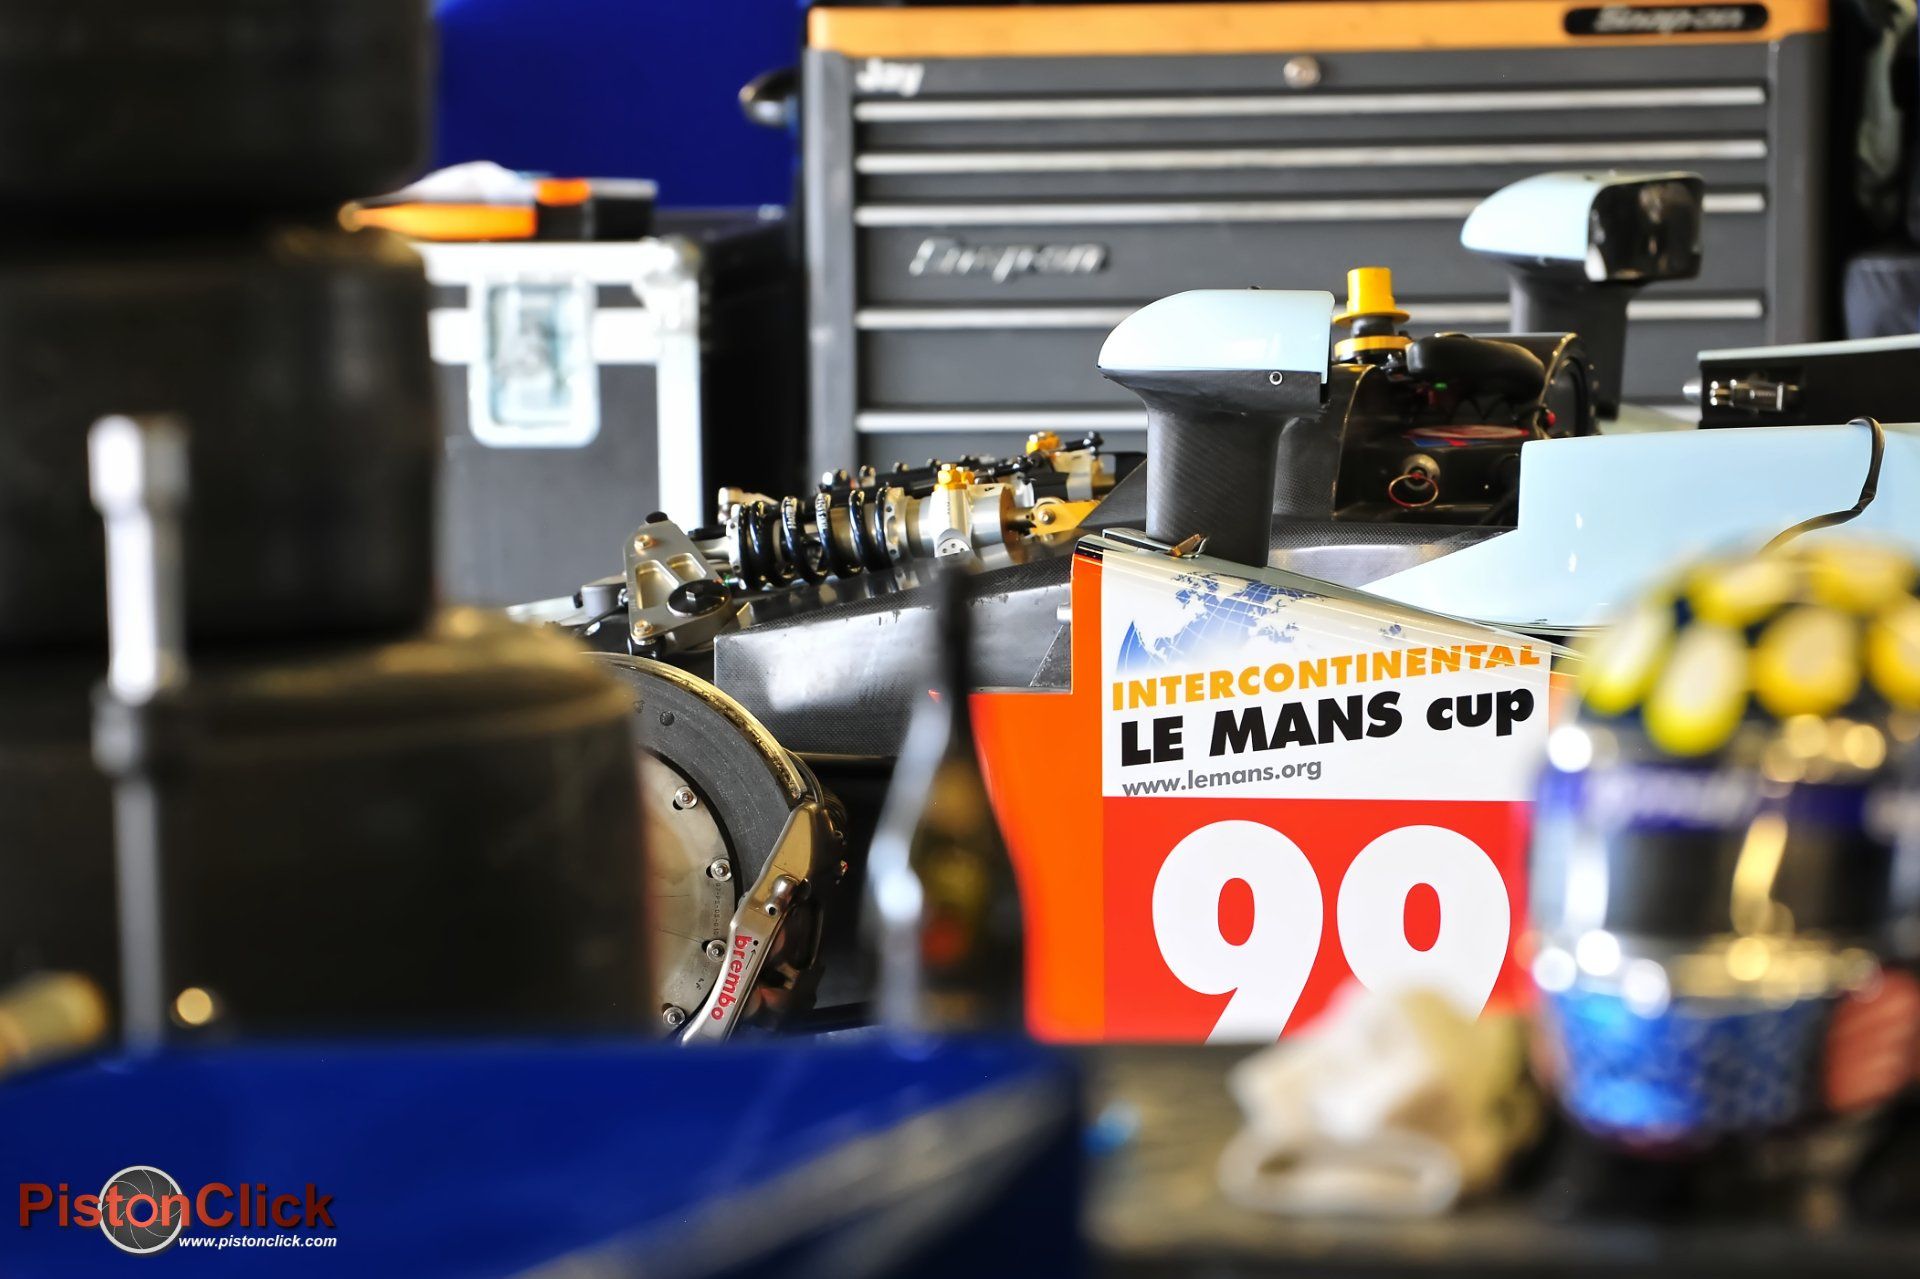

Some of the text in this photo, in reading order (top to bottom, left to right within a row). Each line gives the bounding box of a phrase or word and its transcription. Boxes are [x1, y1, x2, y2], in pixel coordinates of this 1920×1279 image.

[1112, 645, 1540, 711] INTERCONTINENTAL
[1121, 688, 1535, 767] LE MANS cup
[1122, 758, 1322, 797] www.lemans.org
[1152, 819, 1511, 1045] 99
[711, 935, 753, 1020] brembo
